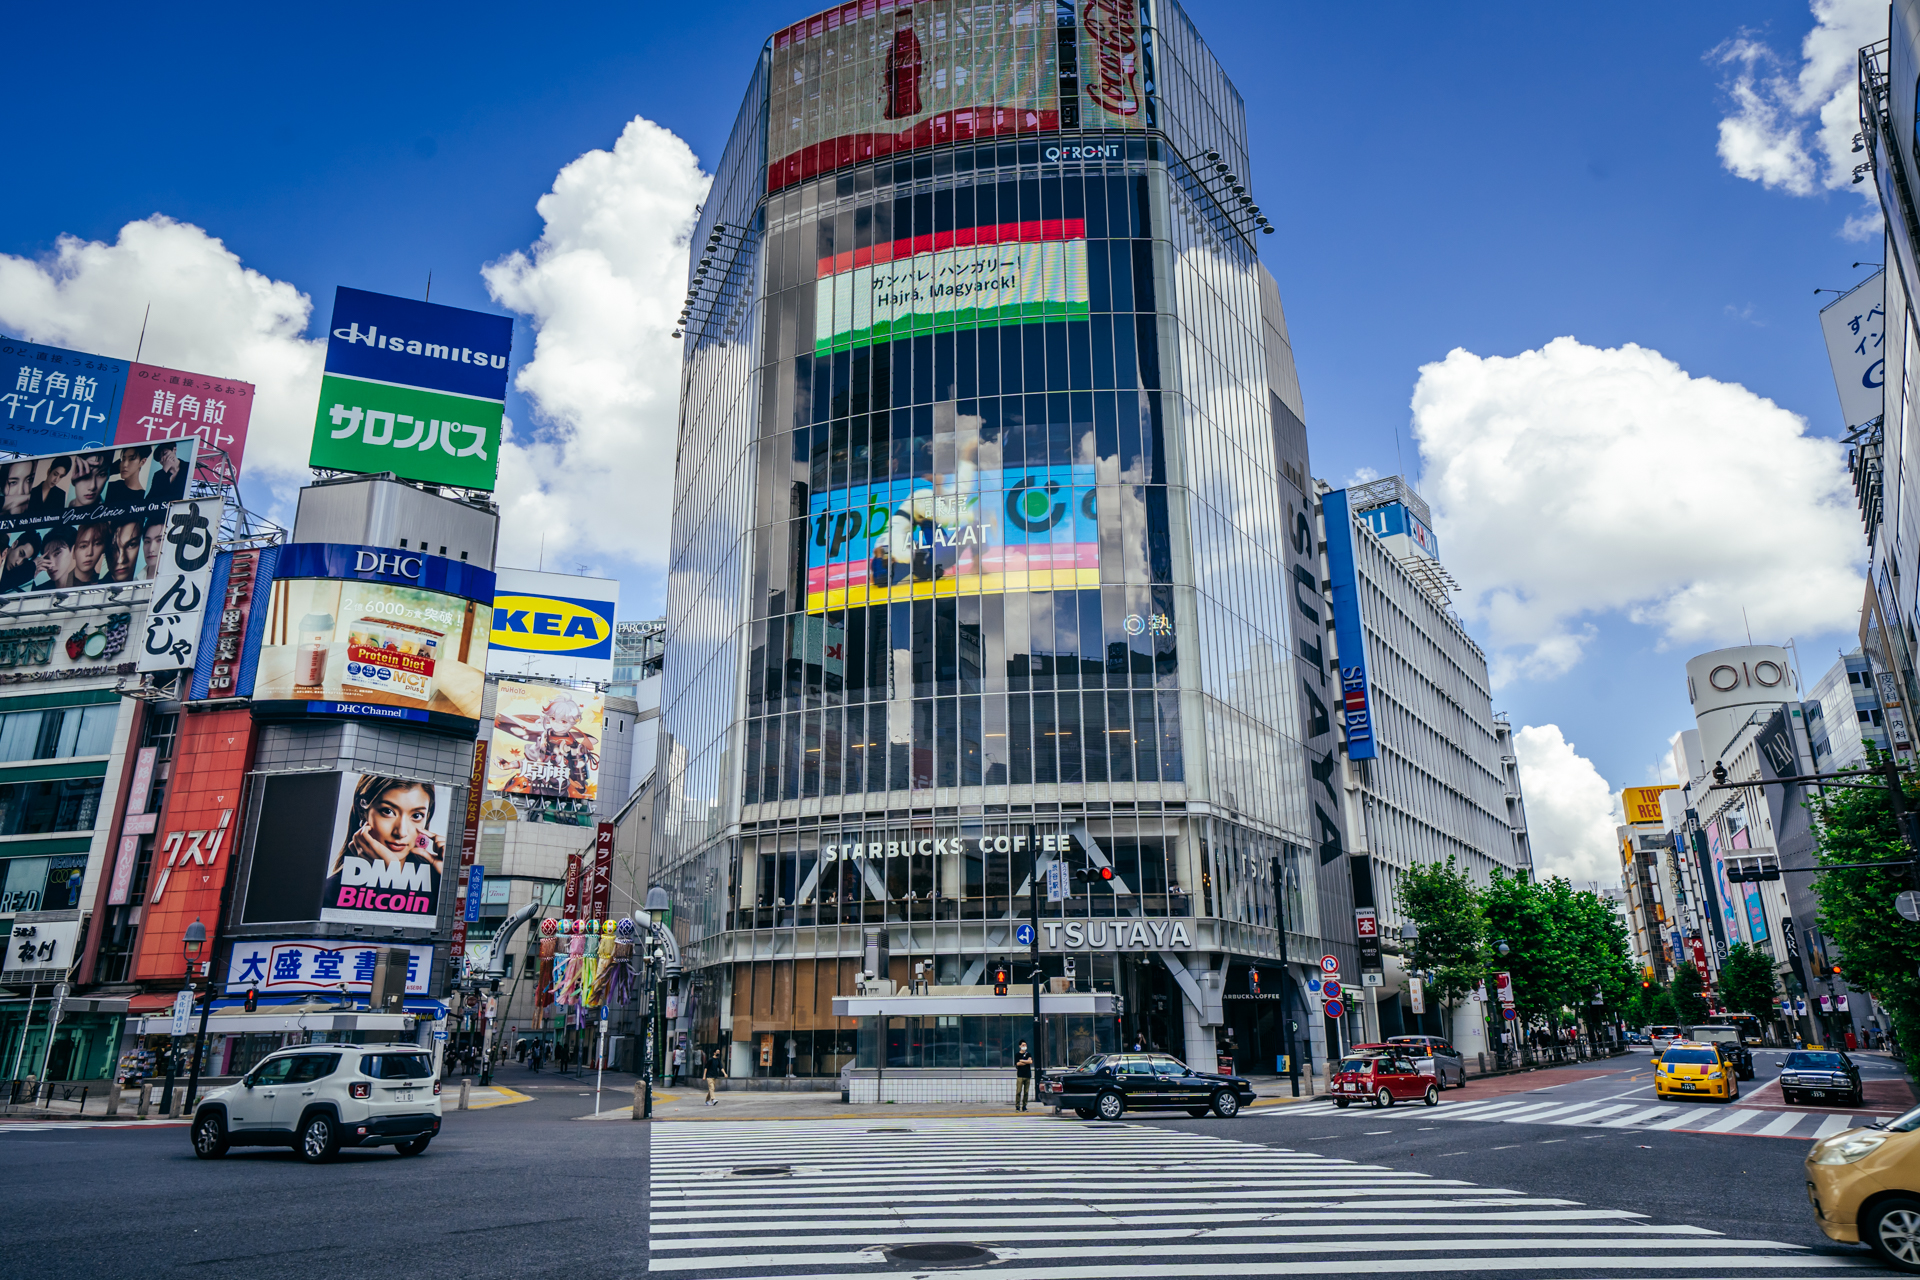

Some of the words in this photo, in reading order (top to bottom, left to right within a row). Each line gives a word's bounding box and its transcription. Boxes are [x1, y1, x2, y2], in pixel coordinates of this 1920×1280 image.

[1046, 145, 1118, 162] QFRONT
[878, 287, 924, 307] Hajrá,
[929, 275, 1015, 298] Magyarok!
[2, 345, 120, 374] のど、直接、うるおう
[333, 322, 506, 369] Hisamitsu
[15, 365, 98, 403] 龍角散
[138, 370, 247, 397] のど、直接、うるおう
[151, 389, 227, 425] 龍角散
[329, 403, 488, 461] サロンパス
[62, 509, 90, 525] Your
[90, 505, 126, 520] Choice
[129, 505, 146, 514] Now
[148, 503, 159, 511] On
[161, 501, 171, 509] Sa
[902, 523, 991, 551] ALÁZAT
[354, 551, 422, 579] DHC
[145, 502, 212, 665] もんじゃ
[618, 623, 652, 634] PARCO
[358, 648, 398, 665] Protein
[402, 659, 425, 671] Diet
[393, 671, 428, 688] MCT
[500, 686, 526, 695] miHoYo
[1881, 674, 1897, 702] 皮ふ科
[337, 704, 360, 714] DHC
[361, 705, 402, 718] Channel
[1343, 665, 1369, 742] SEIBU
[1892, 720, 1906, 740] 内科
[1764, 728, 1794, 773] ZAR
[130, 751, 152, 811] お好み焼
[467, 743, 486, 822] クスリのことなら
[150, 809, 233, 904] クスリ
[826, 837, 963, 861] STARBUCKS
[979, 834, 1070, 853] COFFEE
[112, 838, 133, 902] もんじゃ焼
[340, 856, 432, 892] DMM
[594, 831, 611, 893] カラオケ
[336, 886, 430, 913] Bitcoin
[1043, 921, 1191, 947] TSUTAYA
[1360, 919, 1374, 933] 本
[1783, 923, 1799, 957] ZARA
